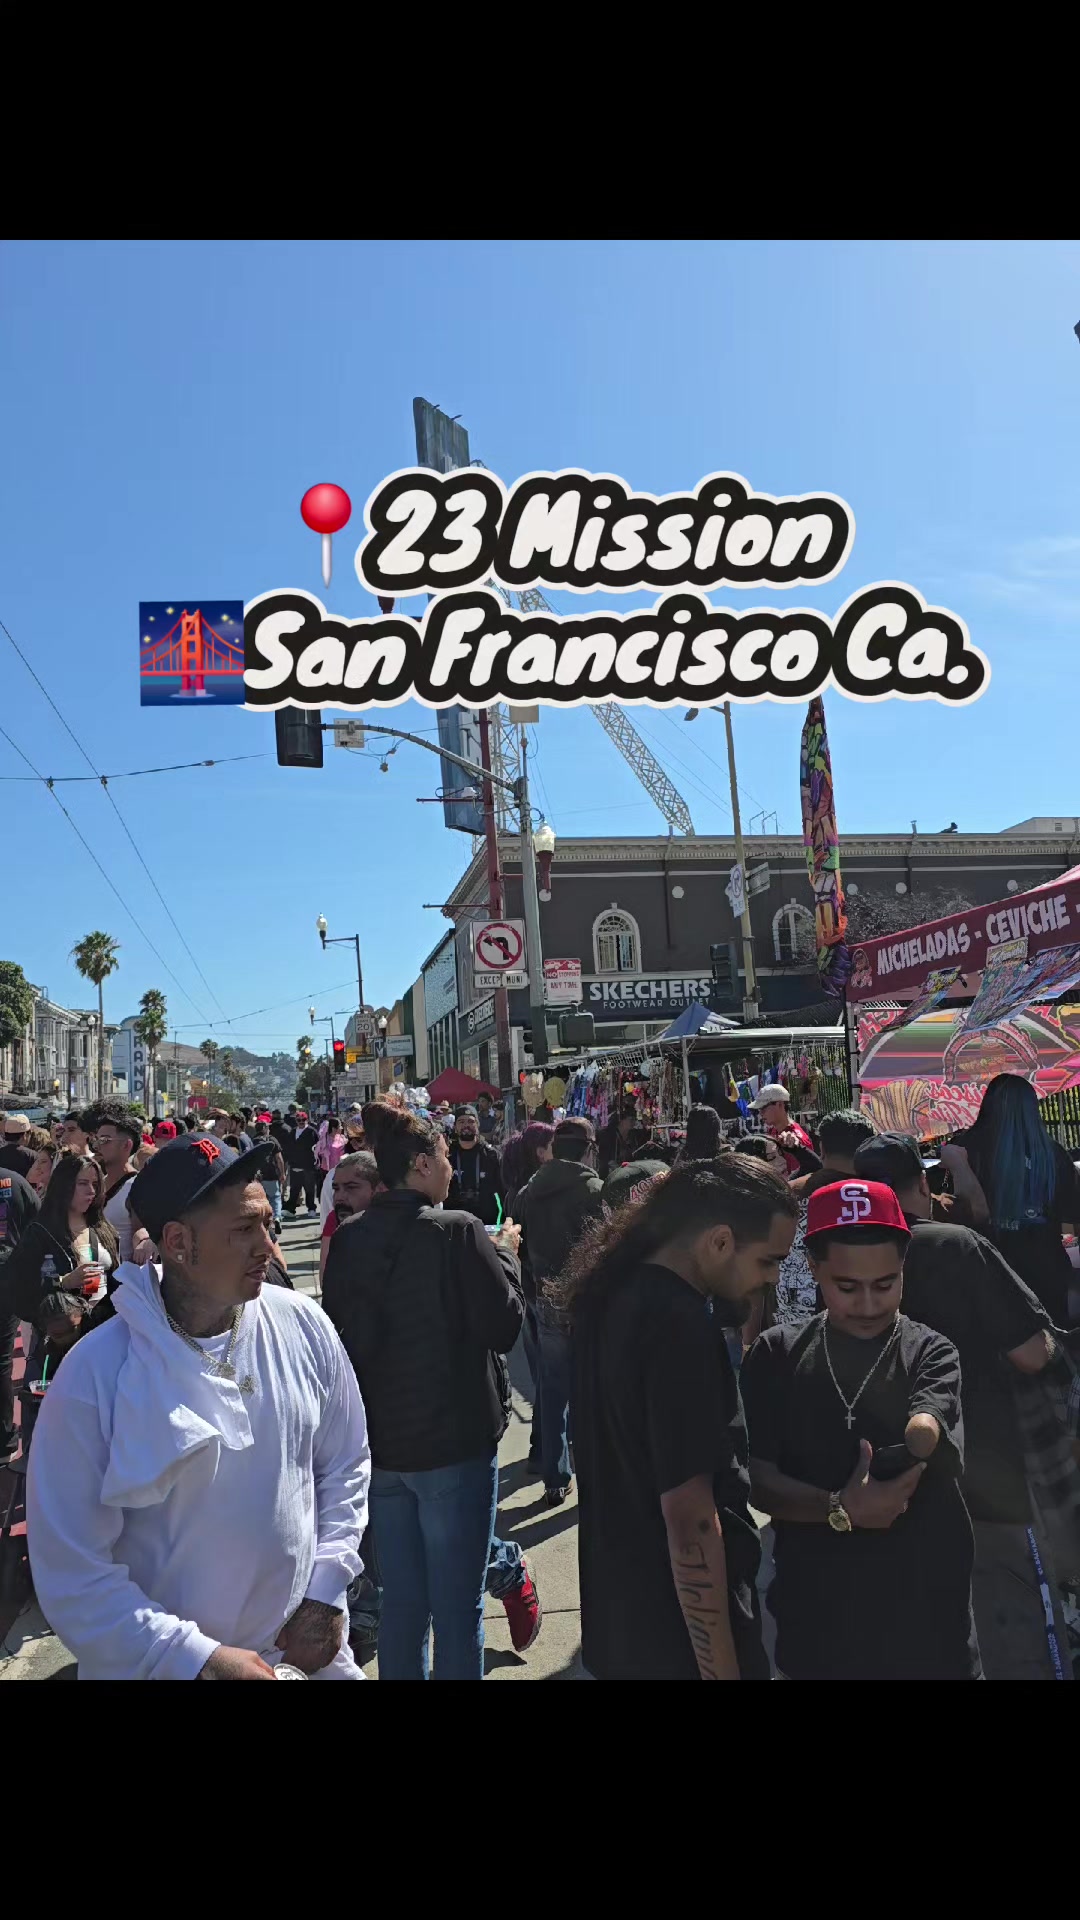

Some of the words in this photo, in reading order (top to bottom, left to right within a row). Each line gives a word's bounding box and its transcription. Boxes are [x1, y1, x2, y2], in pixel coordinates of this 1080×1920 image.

[877, 922, 971, 976] MICHELADAS
[985, 893, 1071, 945] CEVICHE
[546, 971, 558, 979] NO
[480, 975, 500, 986] EXCEP
[506, 975, 523, 985] MUNI
[589, 979, 711, 1001] SKECHERS
[603, 999, 663, 1009] FOOTWEAR
[356, 1023, 370, 1031] 20
